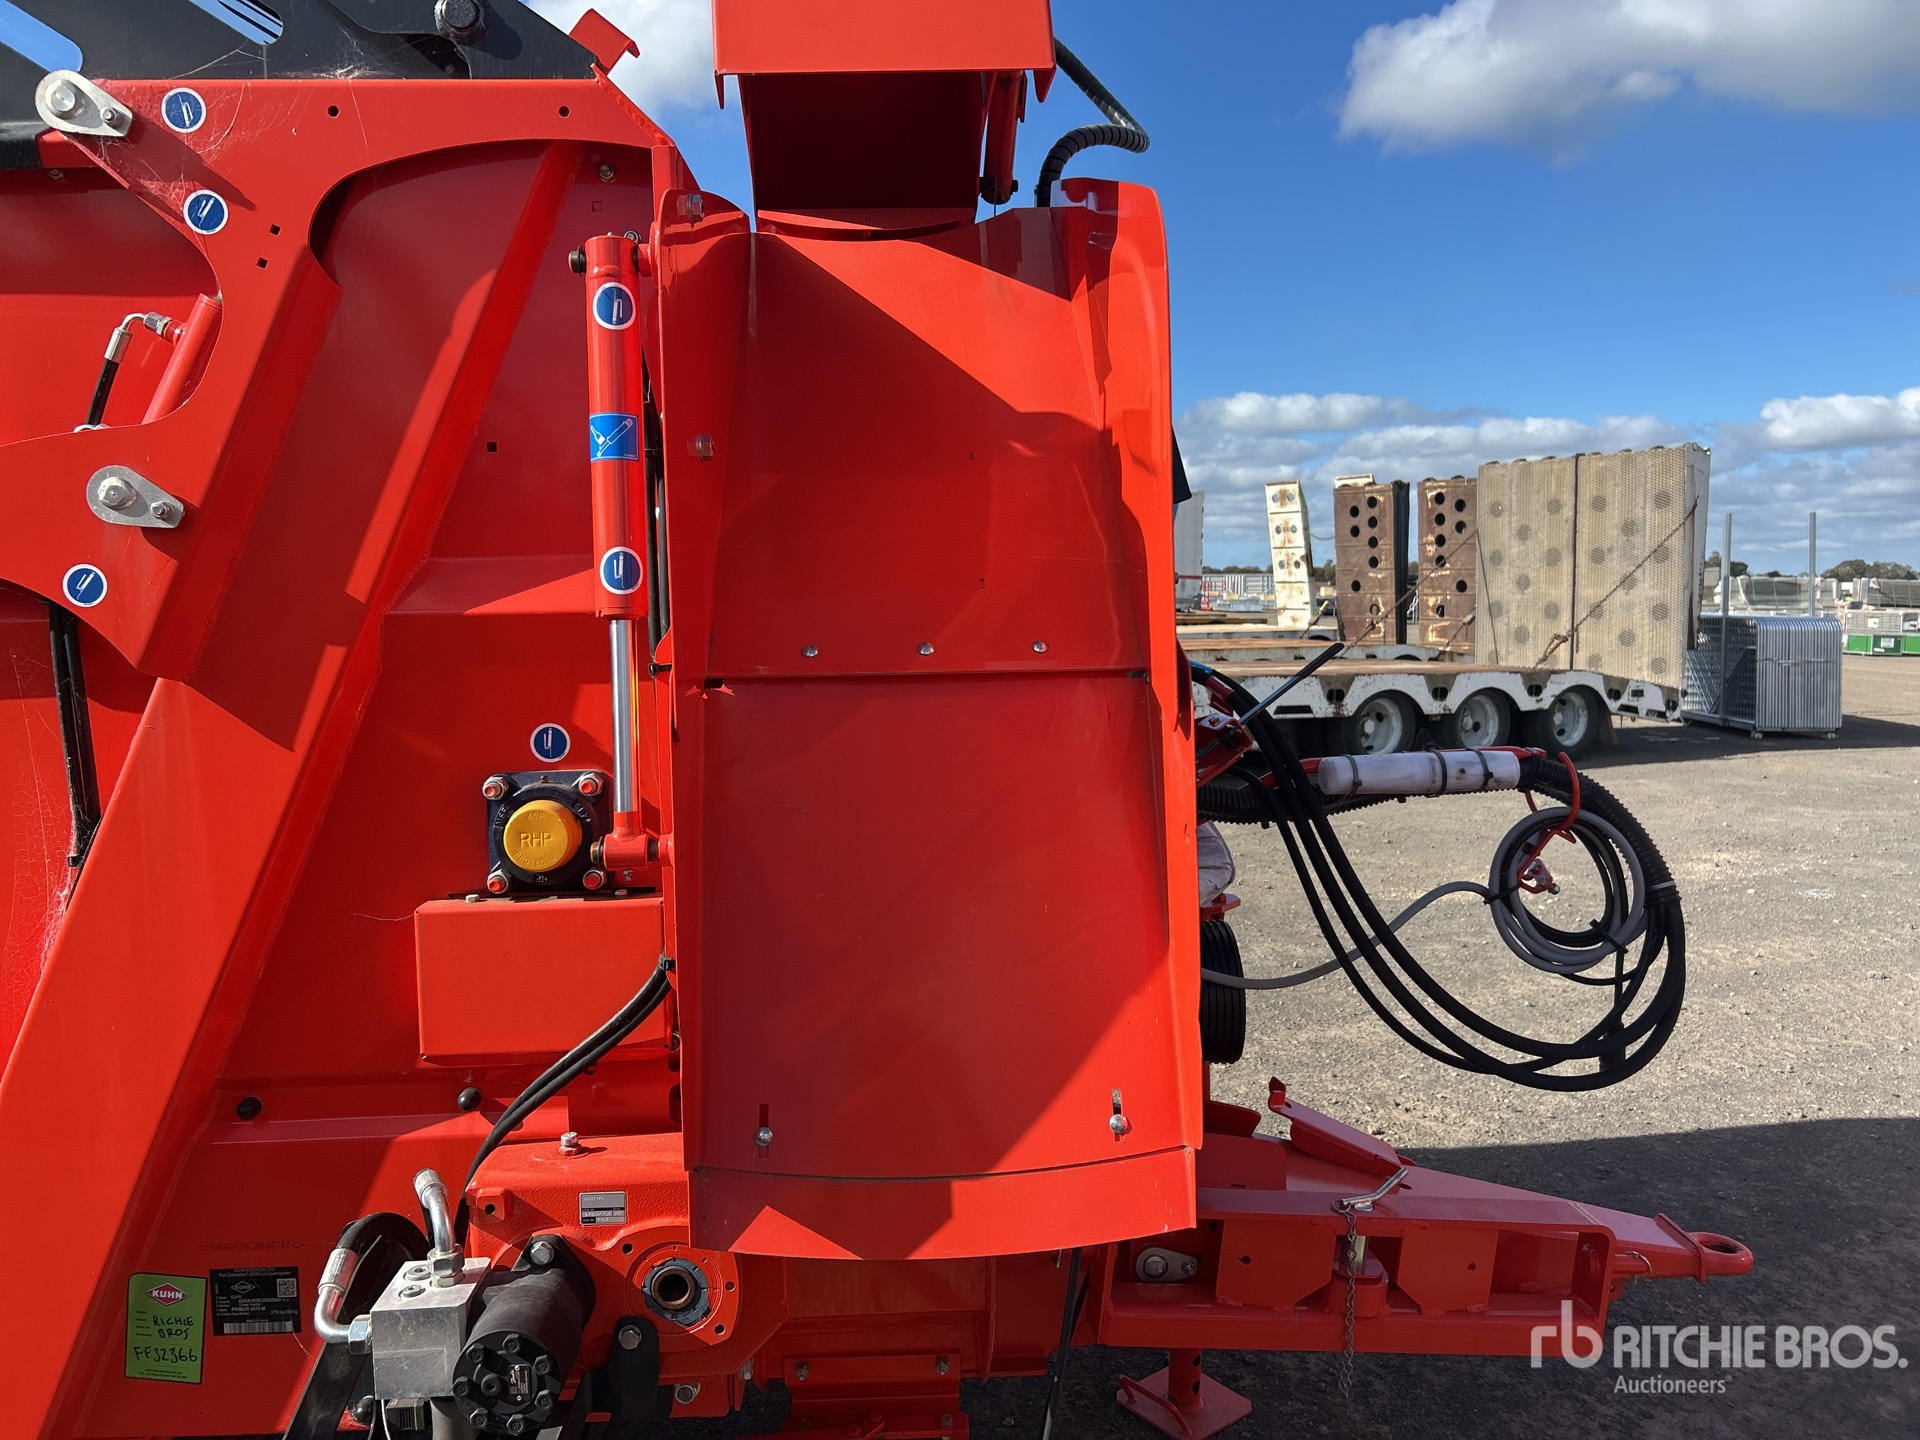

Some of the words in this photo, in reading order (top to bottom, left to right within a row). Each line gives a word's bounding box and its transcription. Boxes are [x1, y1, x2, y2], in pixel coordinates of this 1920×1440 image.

[519, 832, 553, 848] RHP
[152, 1289, 183, 1300] KUHN
[153, 1315, 194, 1327] RICHIE
[158, 1328, 190, 1340] BROS
[133, 1346, 198, 1364] FF32366
